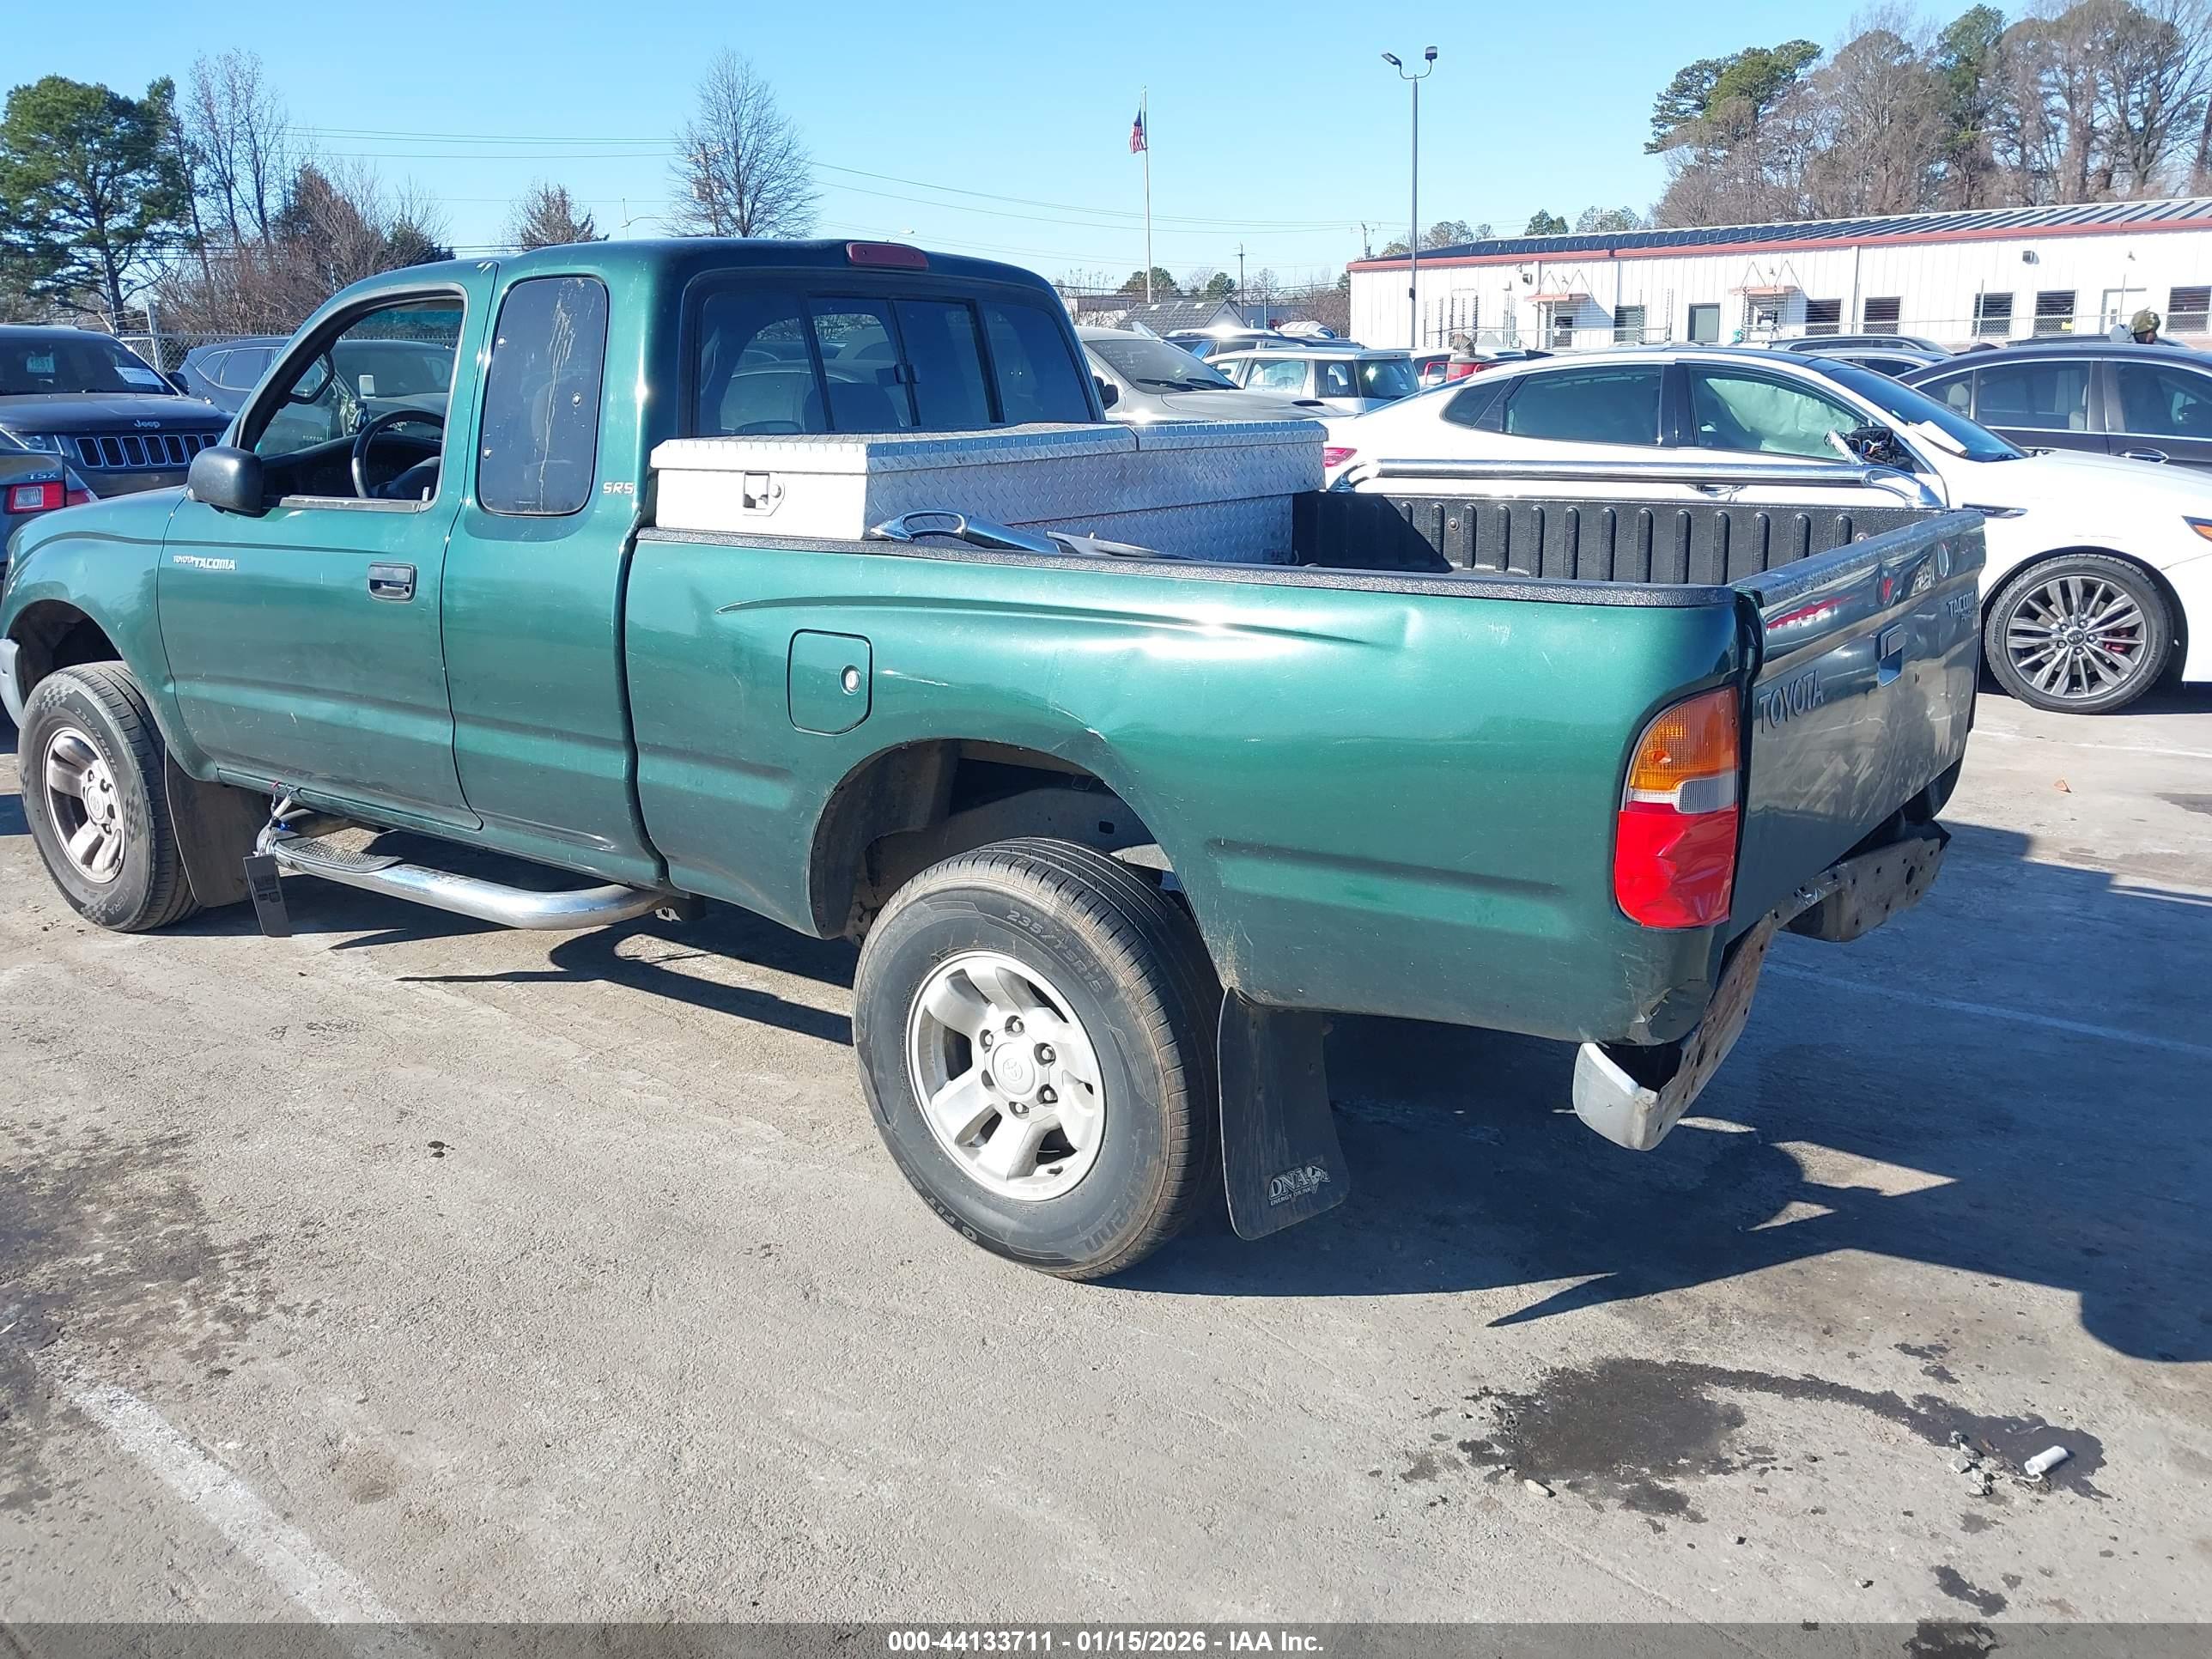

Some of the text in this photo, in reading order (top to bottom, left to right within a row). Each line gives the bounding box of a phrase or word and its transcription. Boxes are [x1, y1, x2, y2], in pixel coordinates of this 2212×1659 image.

[134, 419, 161, 428] Jeep
[193, 556, 236, 570] TACOMA
[1758, 670, 1824, 734] TOYOTA
[1269, 1168, 1310, 1200] DNA
[1270, 1194, 1292, 1206] ENERGY
